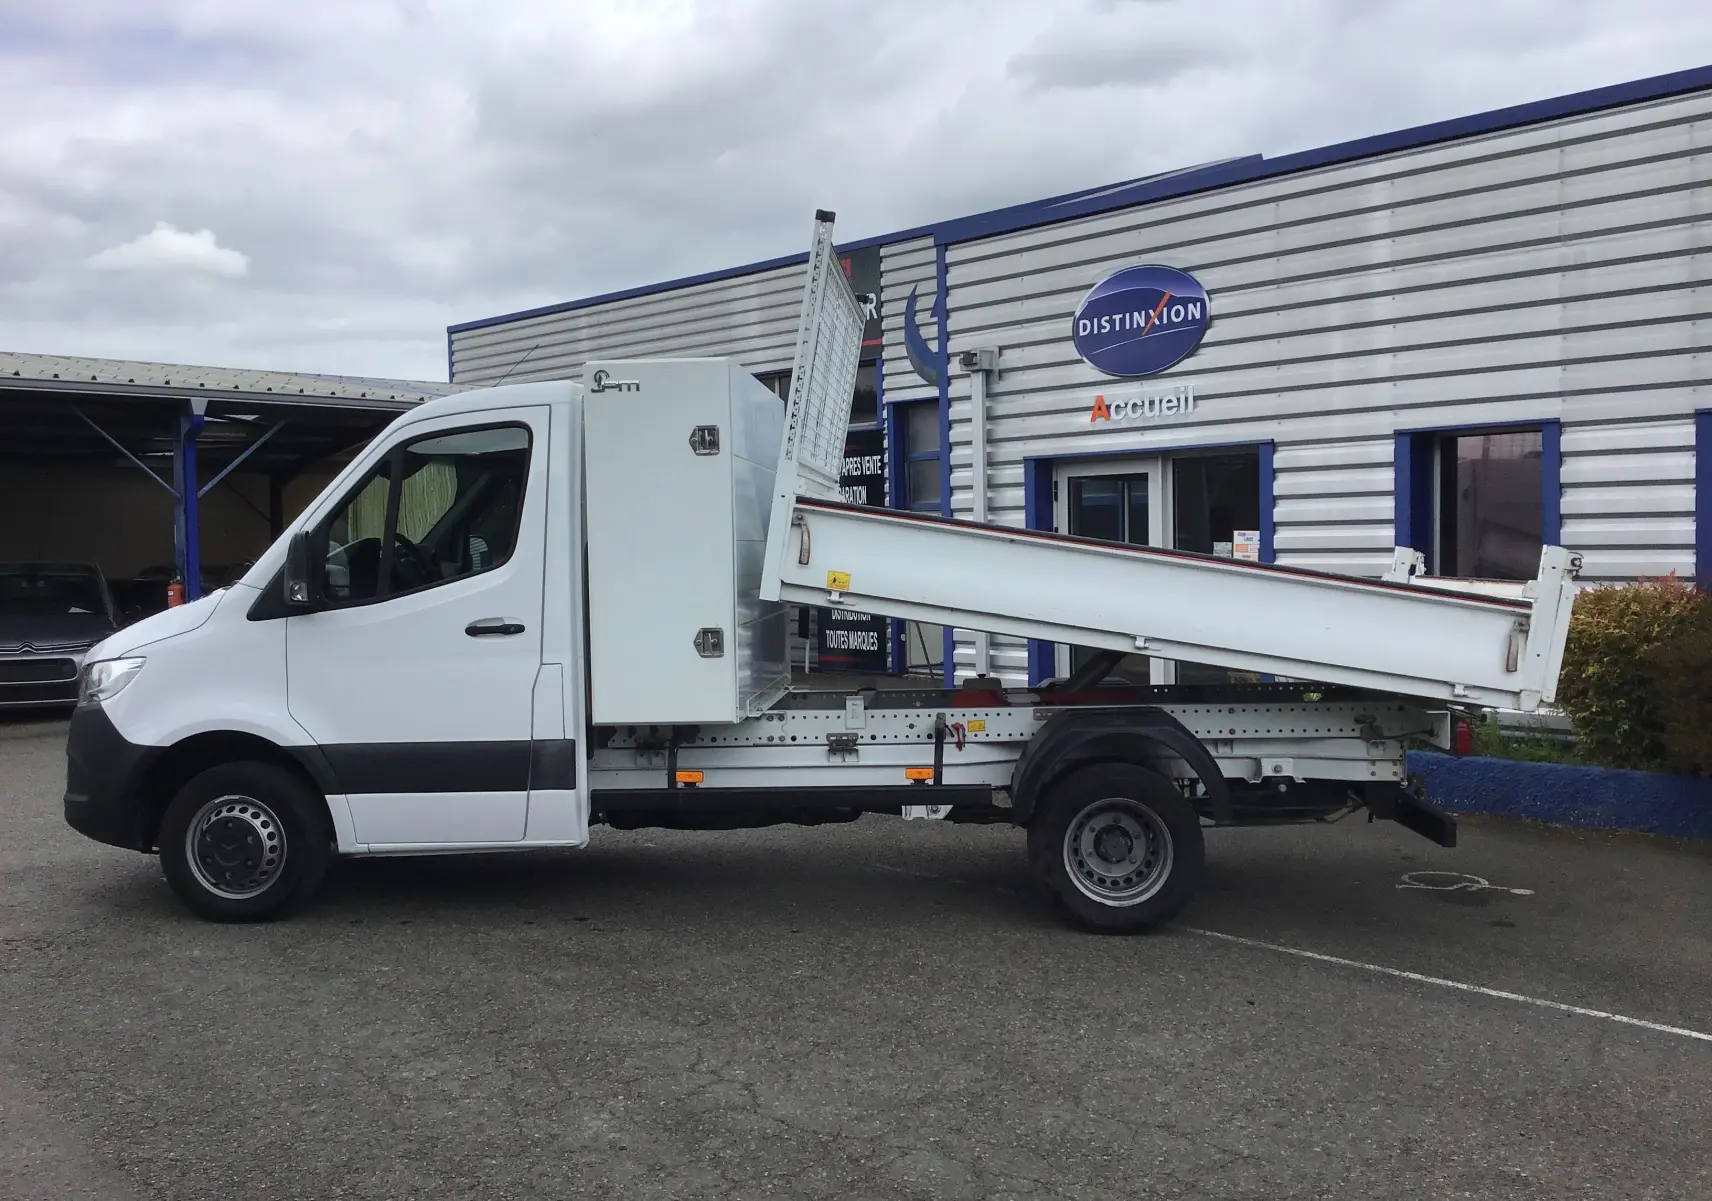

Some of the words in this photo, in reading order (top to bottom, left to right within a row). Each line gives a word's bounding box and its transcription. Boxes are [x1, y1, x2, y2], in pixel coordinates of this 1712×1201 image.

[1079, 290, 1201, 337] DISTINXION
[1090, 384, 1195, 423] Accueil
[841, 456, 861, 476] APRES
[861, 455, 882, 475] VENTE
[825, 629, 848, 649] TOUTES
[849, 630, 878, 651] MARQUES
